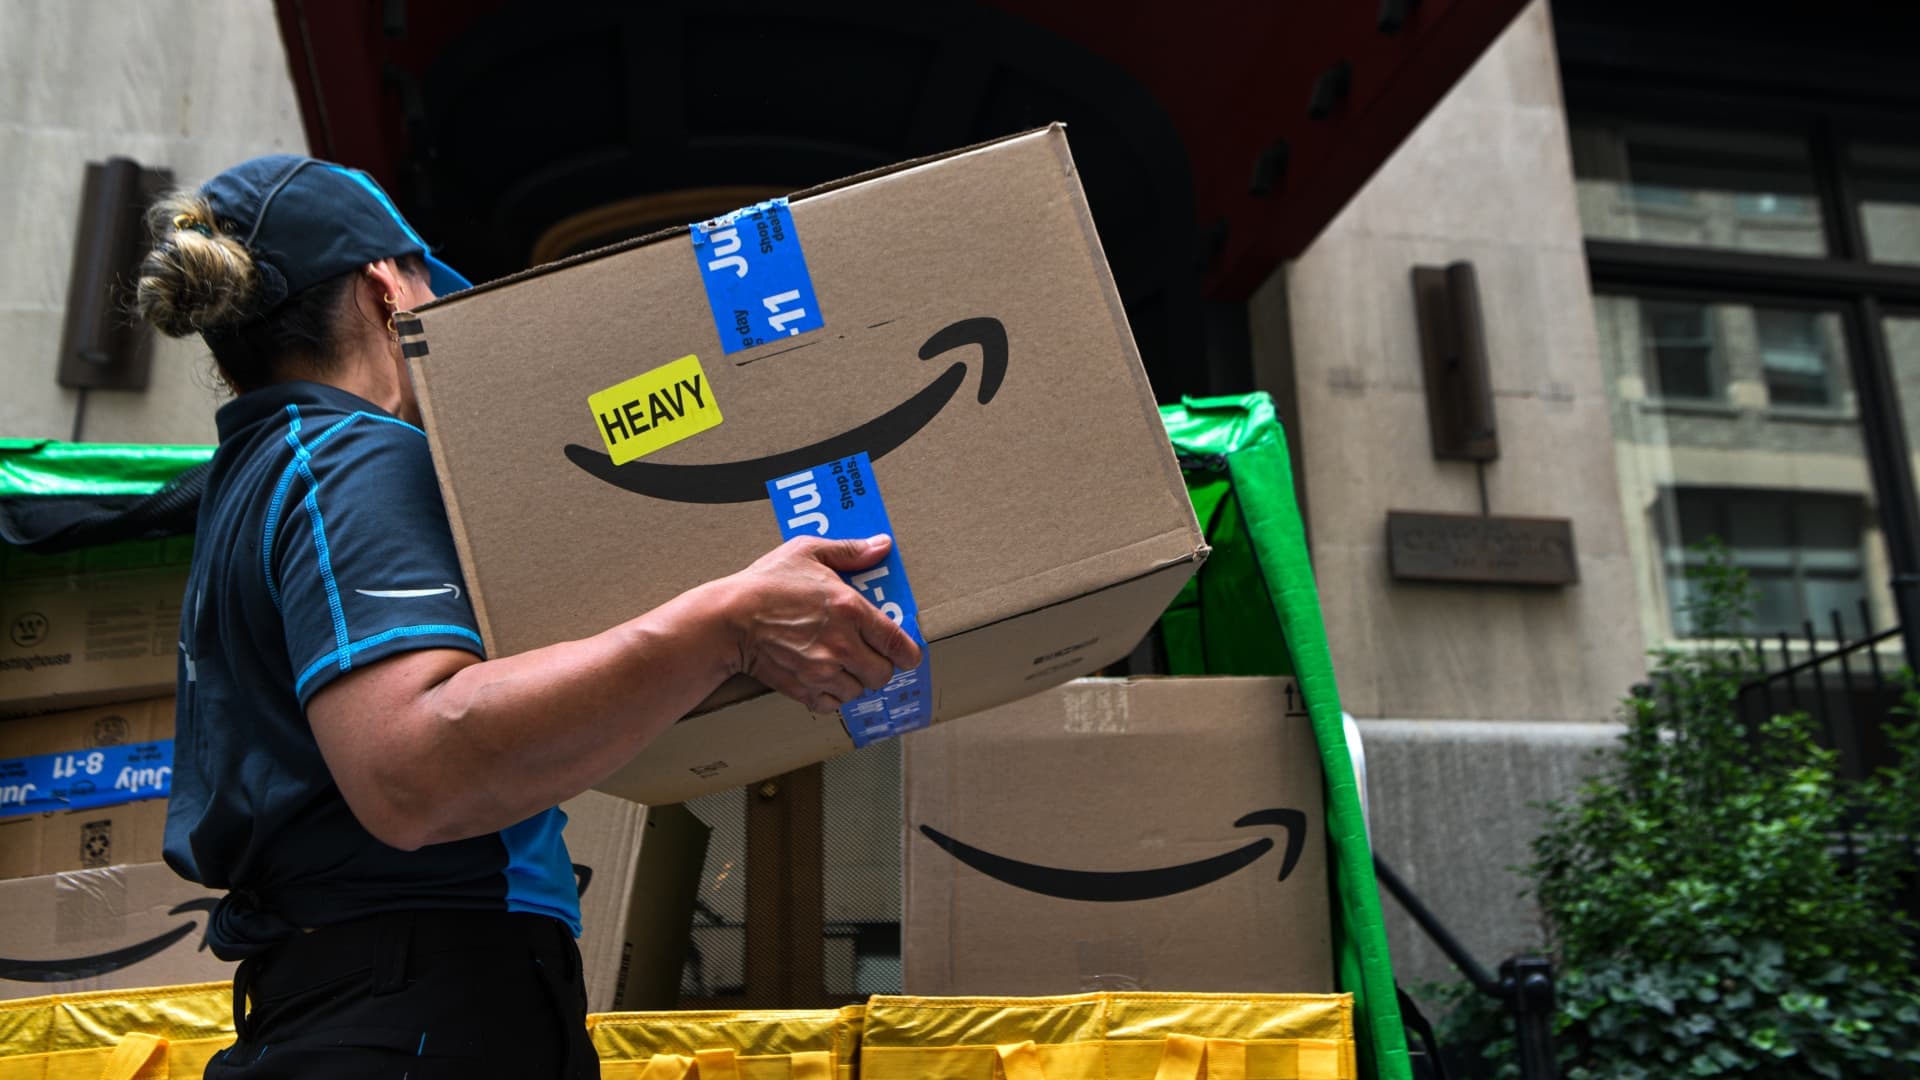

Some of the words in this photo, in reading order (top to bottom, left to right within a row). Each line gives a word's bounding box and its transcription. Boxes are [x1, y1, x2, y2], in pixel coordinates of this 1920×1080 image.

[757, 222, 773, 254] Shop
[734, 309, 750, 335] day
[600, 374, 704, 445] HEAVY
[775, 469, 830, 537] Jul
[837, 476, 854, 510] Shop
[52, 751, 105, 779] 8-11
[114, 766, 172, 793] July
